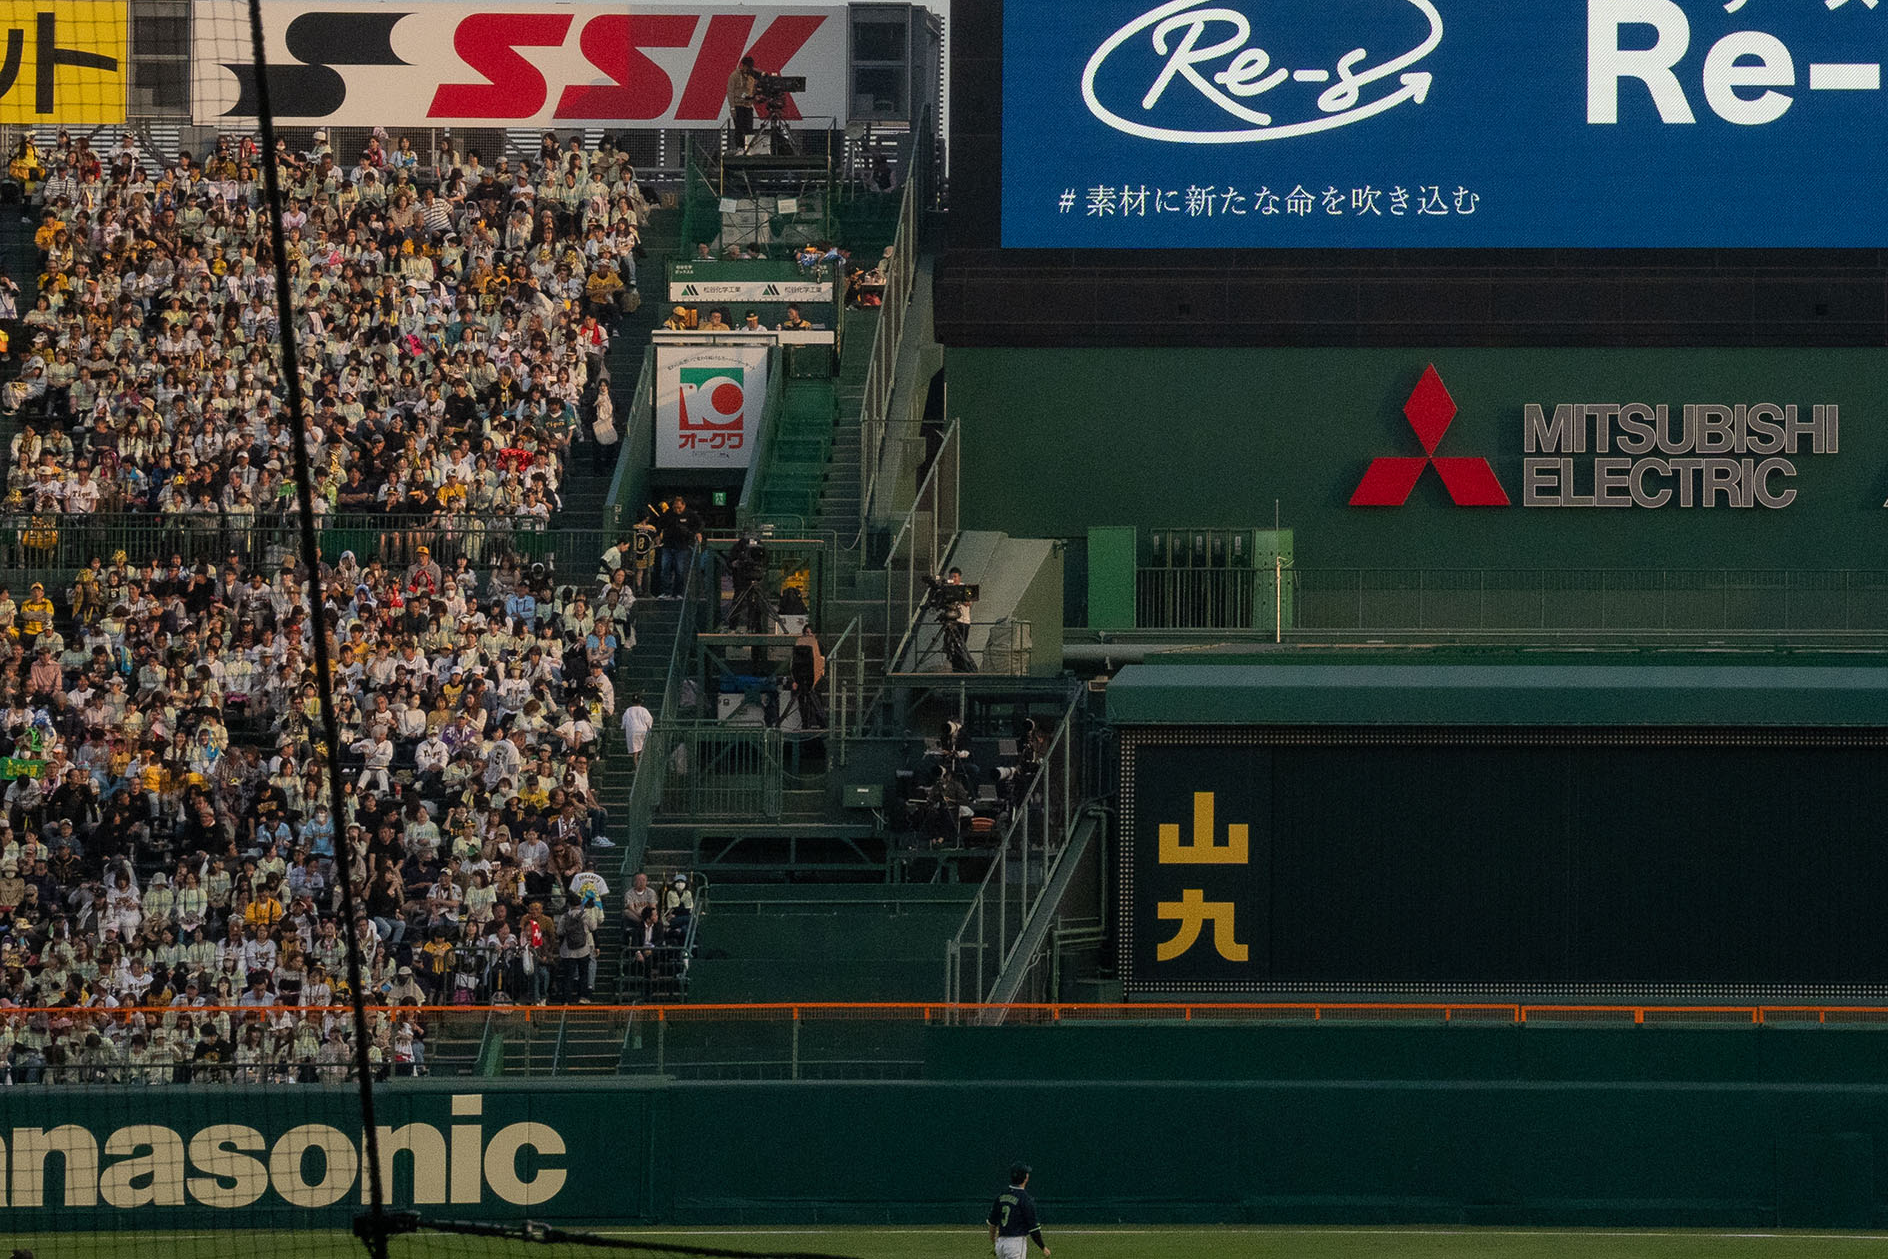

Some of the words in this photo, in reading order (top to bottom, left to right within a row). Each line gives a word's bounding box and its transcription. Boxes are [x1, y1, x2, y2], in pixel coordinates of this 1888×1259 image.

[426, 12, 827, 121] SSK
[679, 433, 743, 449] オークワ
[1523, 403, 1839, 453] MITSUBISHI
[1523, 457, 1798, 509] ELECTRIC
[1156, 791, 1249, 963] 山九
[0, 1093, 568, 1208] nasonic
